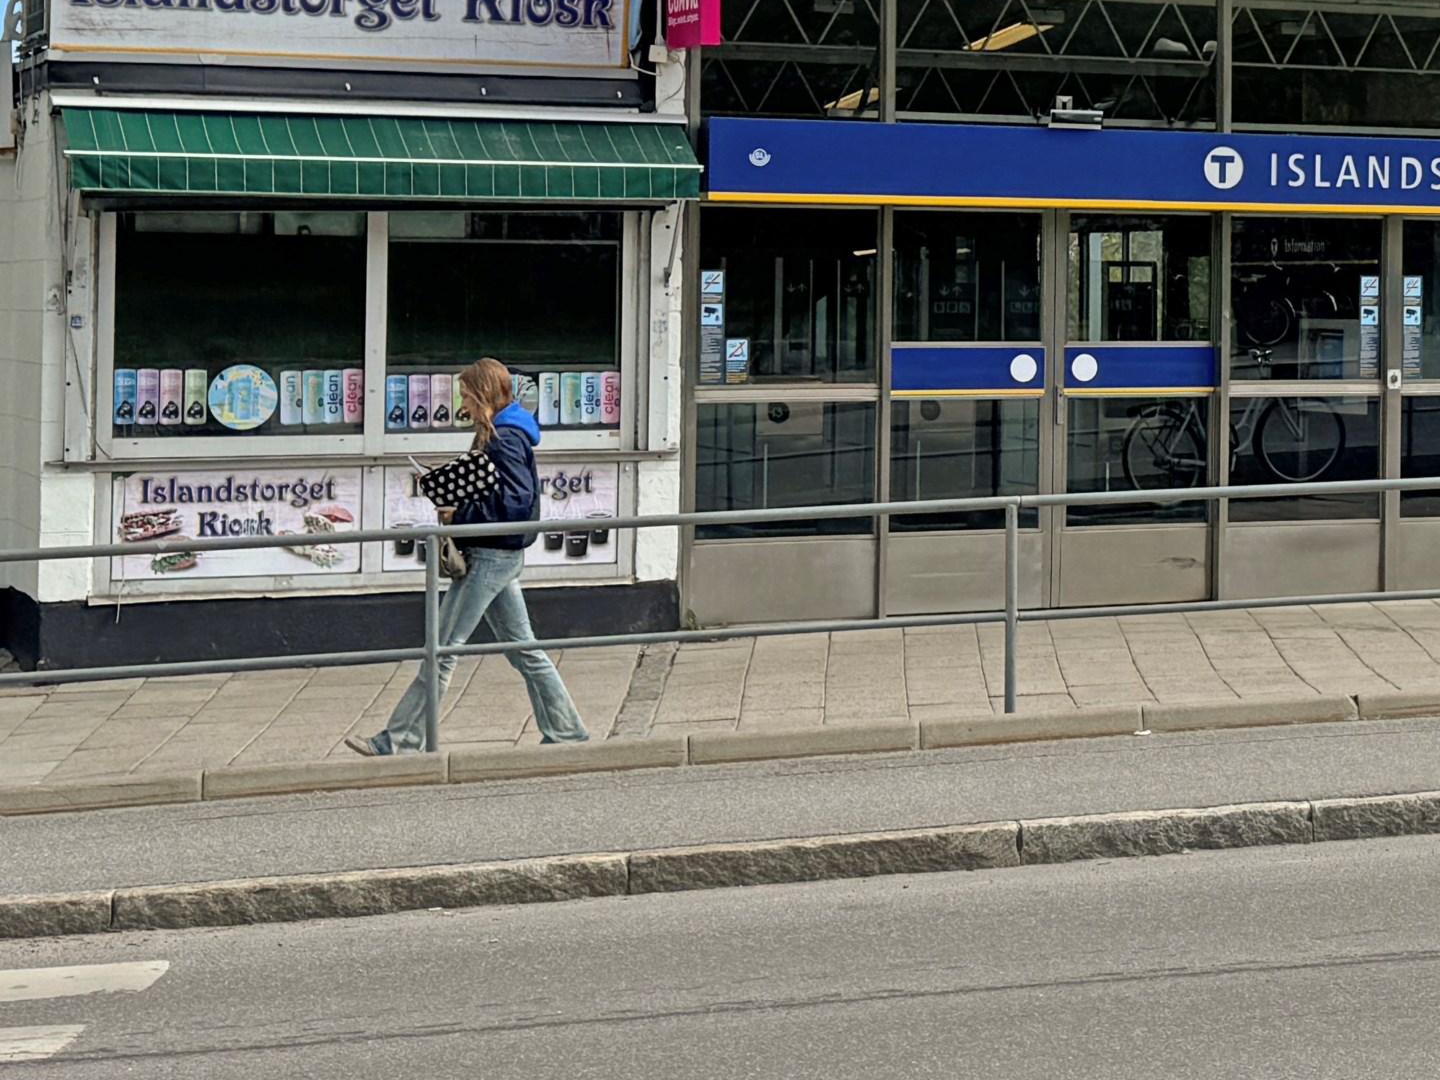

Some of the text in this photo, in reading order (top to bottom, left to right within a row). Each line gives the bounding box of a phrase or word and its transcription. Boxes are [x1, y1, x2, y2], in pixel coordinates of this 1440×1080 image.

[584, 376, 595, 415] clean
[604, 376, 615, 415] clean
[140, 475, 337, 507] Islandstorget
